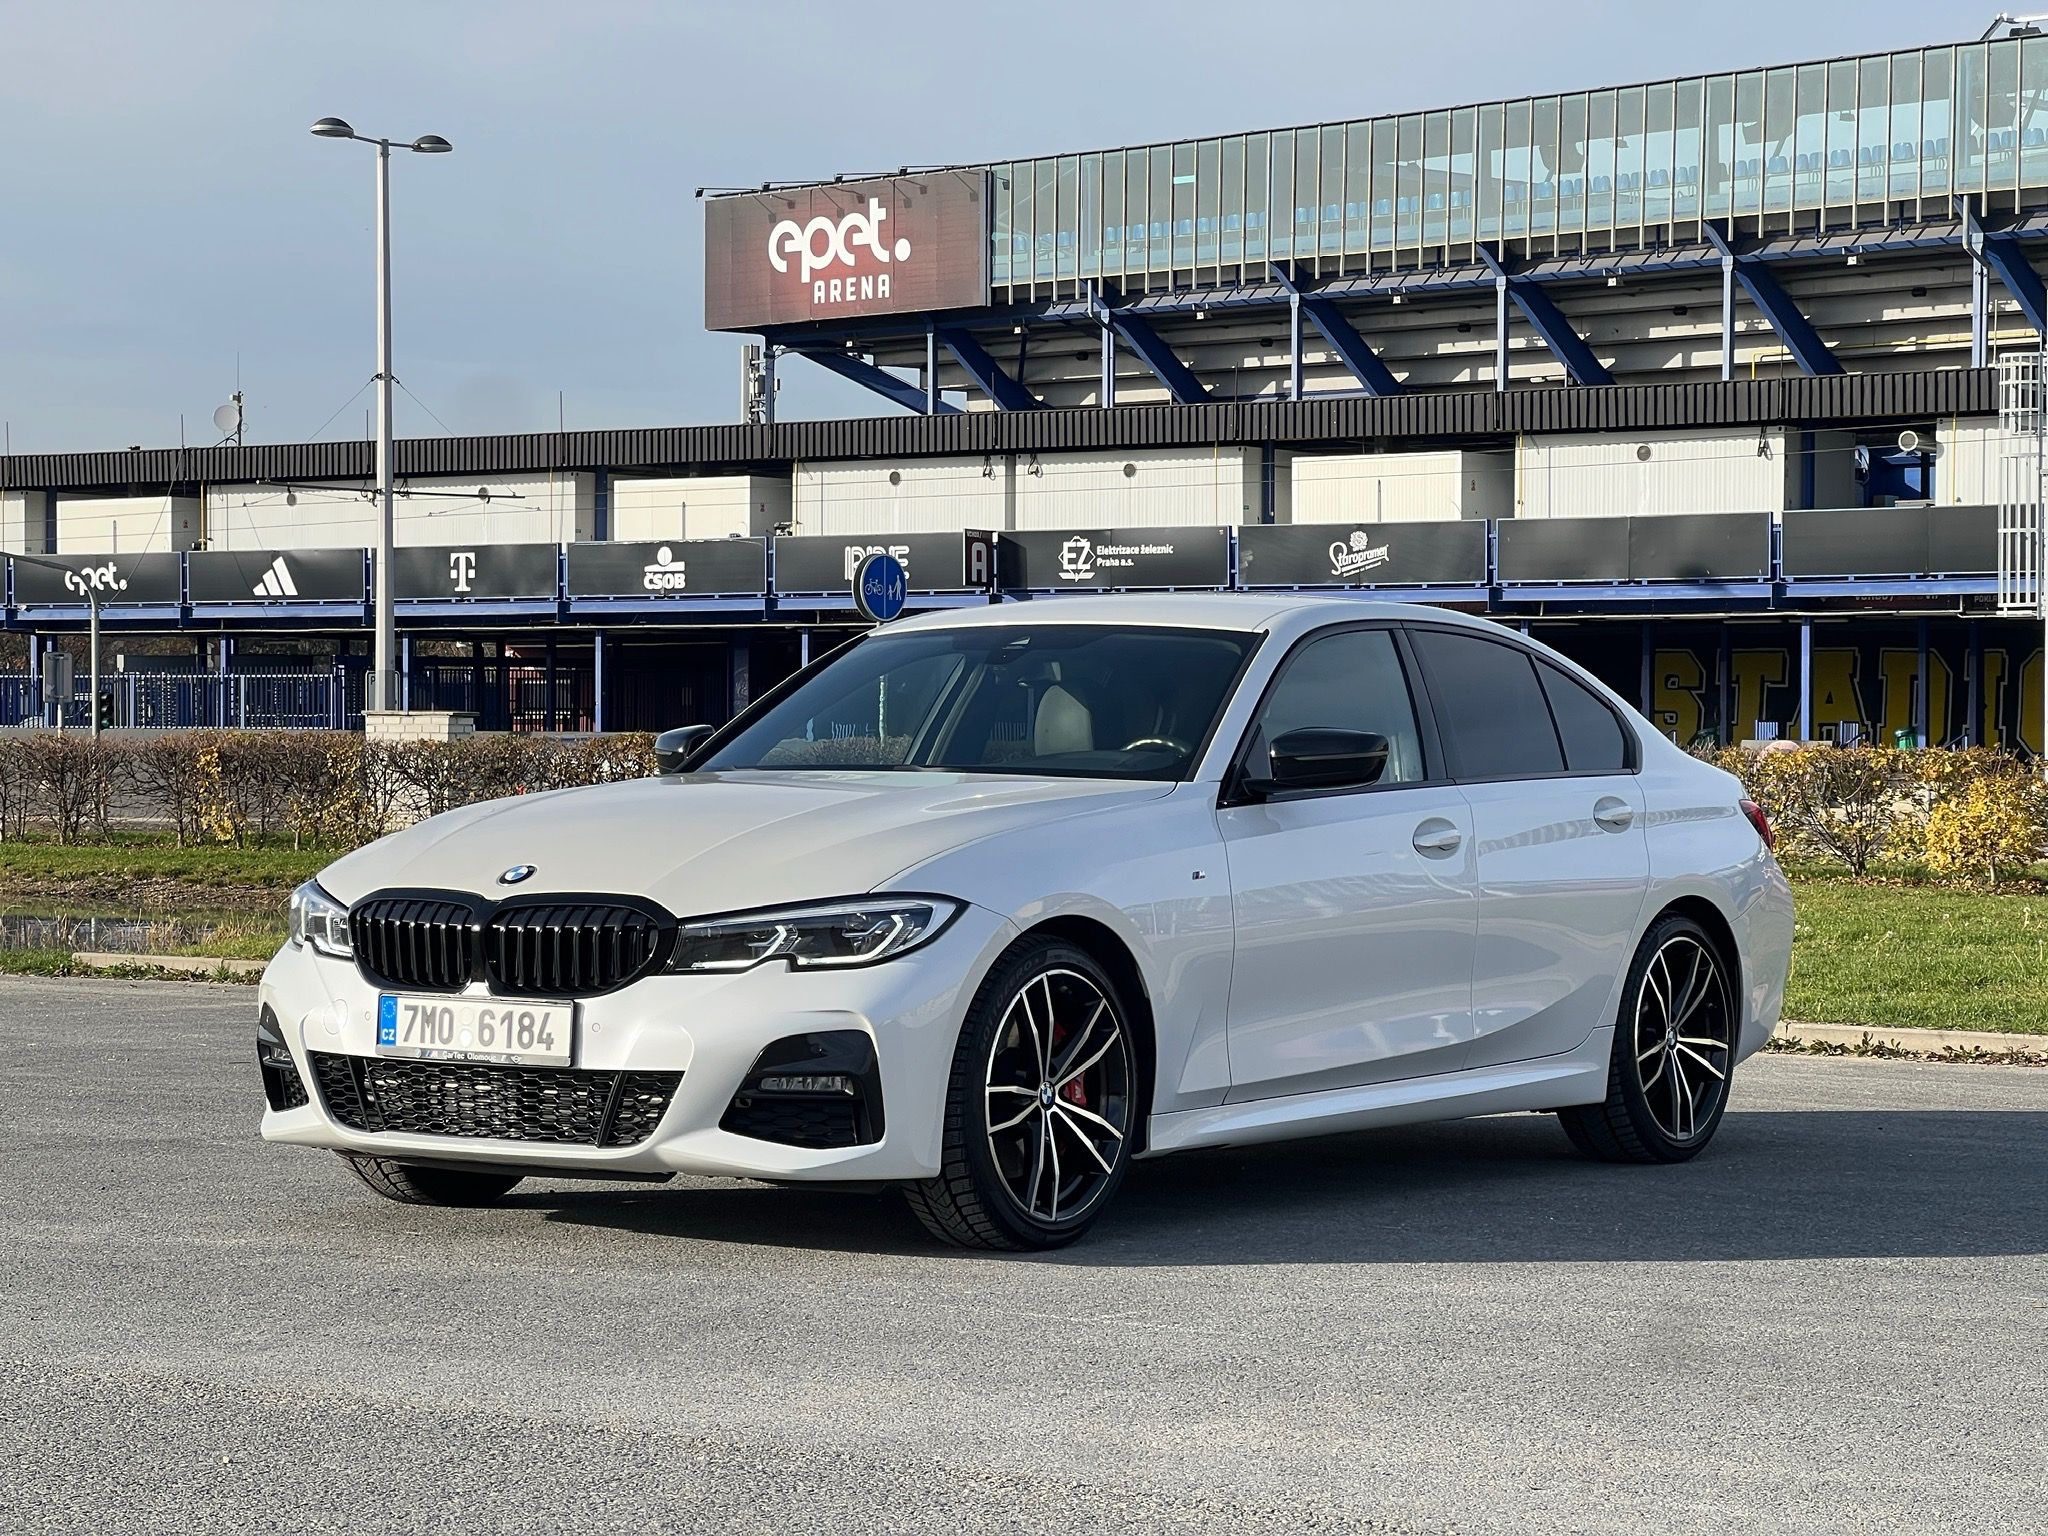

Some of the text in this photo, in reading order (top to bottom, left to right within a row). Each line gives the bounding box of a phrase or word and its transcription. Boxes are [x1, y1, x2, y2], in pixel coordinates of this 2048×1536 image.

[813, 274, 890, 304] ARENA
[1096, 544, 1174, 556] Elektrizace železnic
[1329, 542, 1389, 575] Staropramen
[450, 552, 476, 592] T
[971, 542, 988, 583] A
[1096, 558, 1120, 567] Praha
[643, 572, 686, 590] ČSOB
[381, 1028, 395, 1041] CZ
[477, 1009, 554, 1051] 6184
[442, 1051, 497, 1062] CarTec Olomouc
